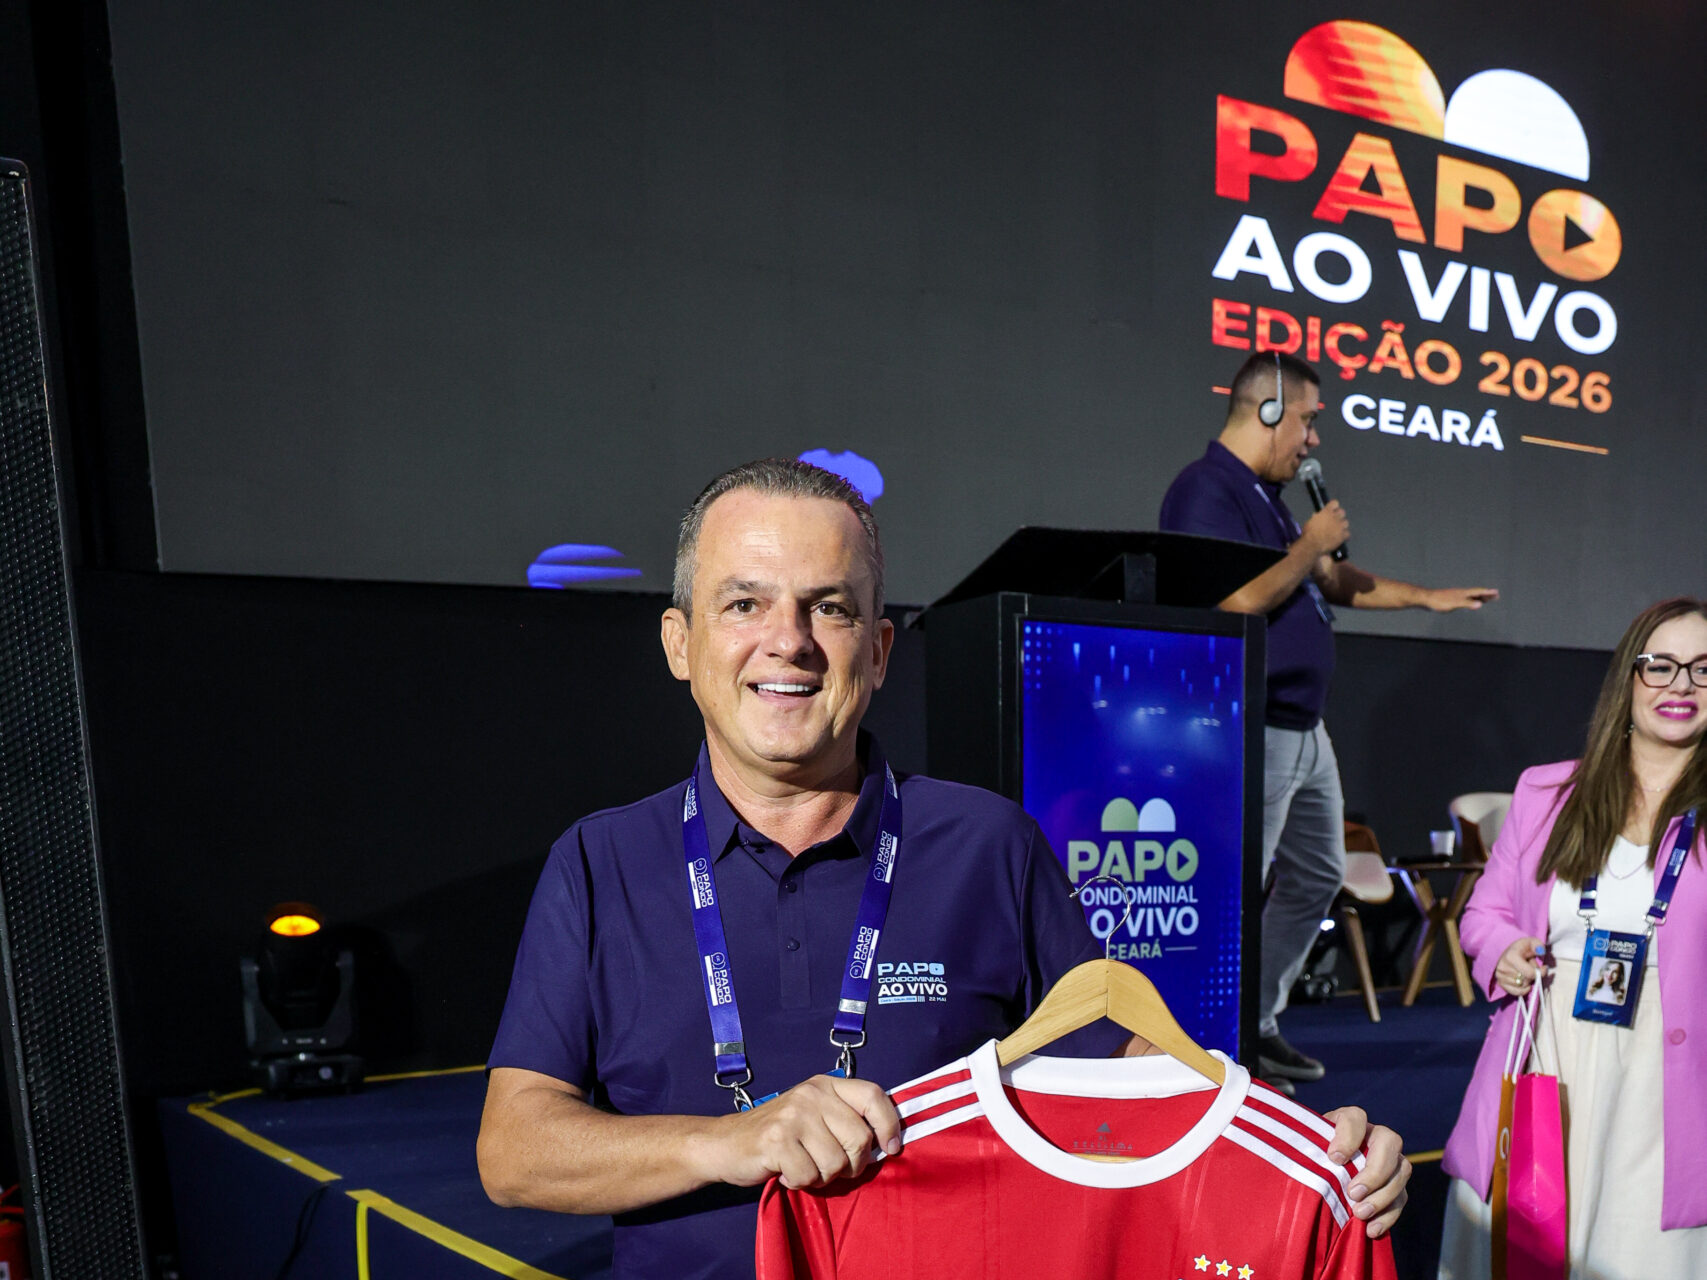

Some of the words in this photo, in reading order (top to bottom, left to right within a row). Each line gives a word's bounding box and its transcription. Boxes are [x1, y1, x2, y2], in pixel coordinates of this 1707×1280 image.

[1215, 94, 1622, 282] PAPO
[1211, 214, 1372, 304] AO
[1397, 249, 1617, 355] VIVO
[1211, 298, 1462, 386] EDIÇÃO
[1478, 351, 1612, 414] 2026
[1341, 394, 1504, 451] CEARÁ
[877, 830, 888, 863] PAPO
[882, 833, 892, 865] CONDO
[1068, 838, 1199, 883] PAPO
[696, 875, 708, 908] CONDO
[702, 873, 714, 906] PAPO
[1075, 885, 1199, 907] ONDOMINIAL
[1090, 908, 1115, 939] O
[1123, 905, 1199, 938] VIVO
[853, 926, 868, 960] PAPO
[860, 927, 874, 961] CONDO
[877, 962, 945, 976] PAPO
[714, 970, 725, 1005] CONDO
[720, 969, 732, 1004] PAPO
[878, 983, 904, 997] AO
[906, 983, 948, 995] VIVO
